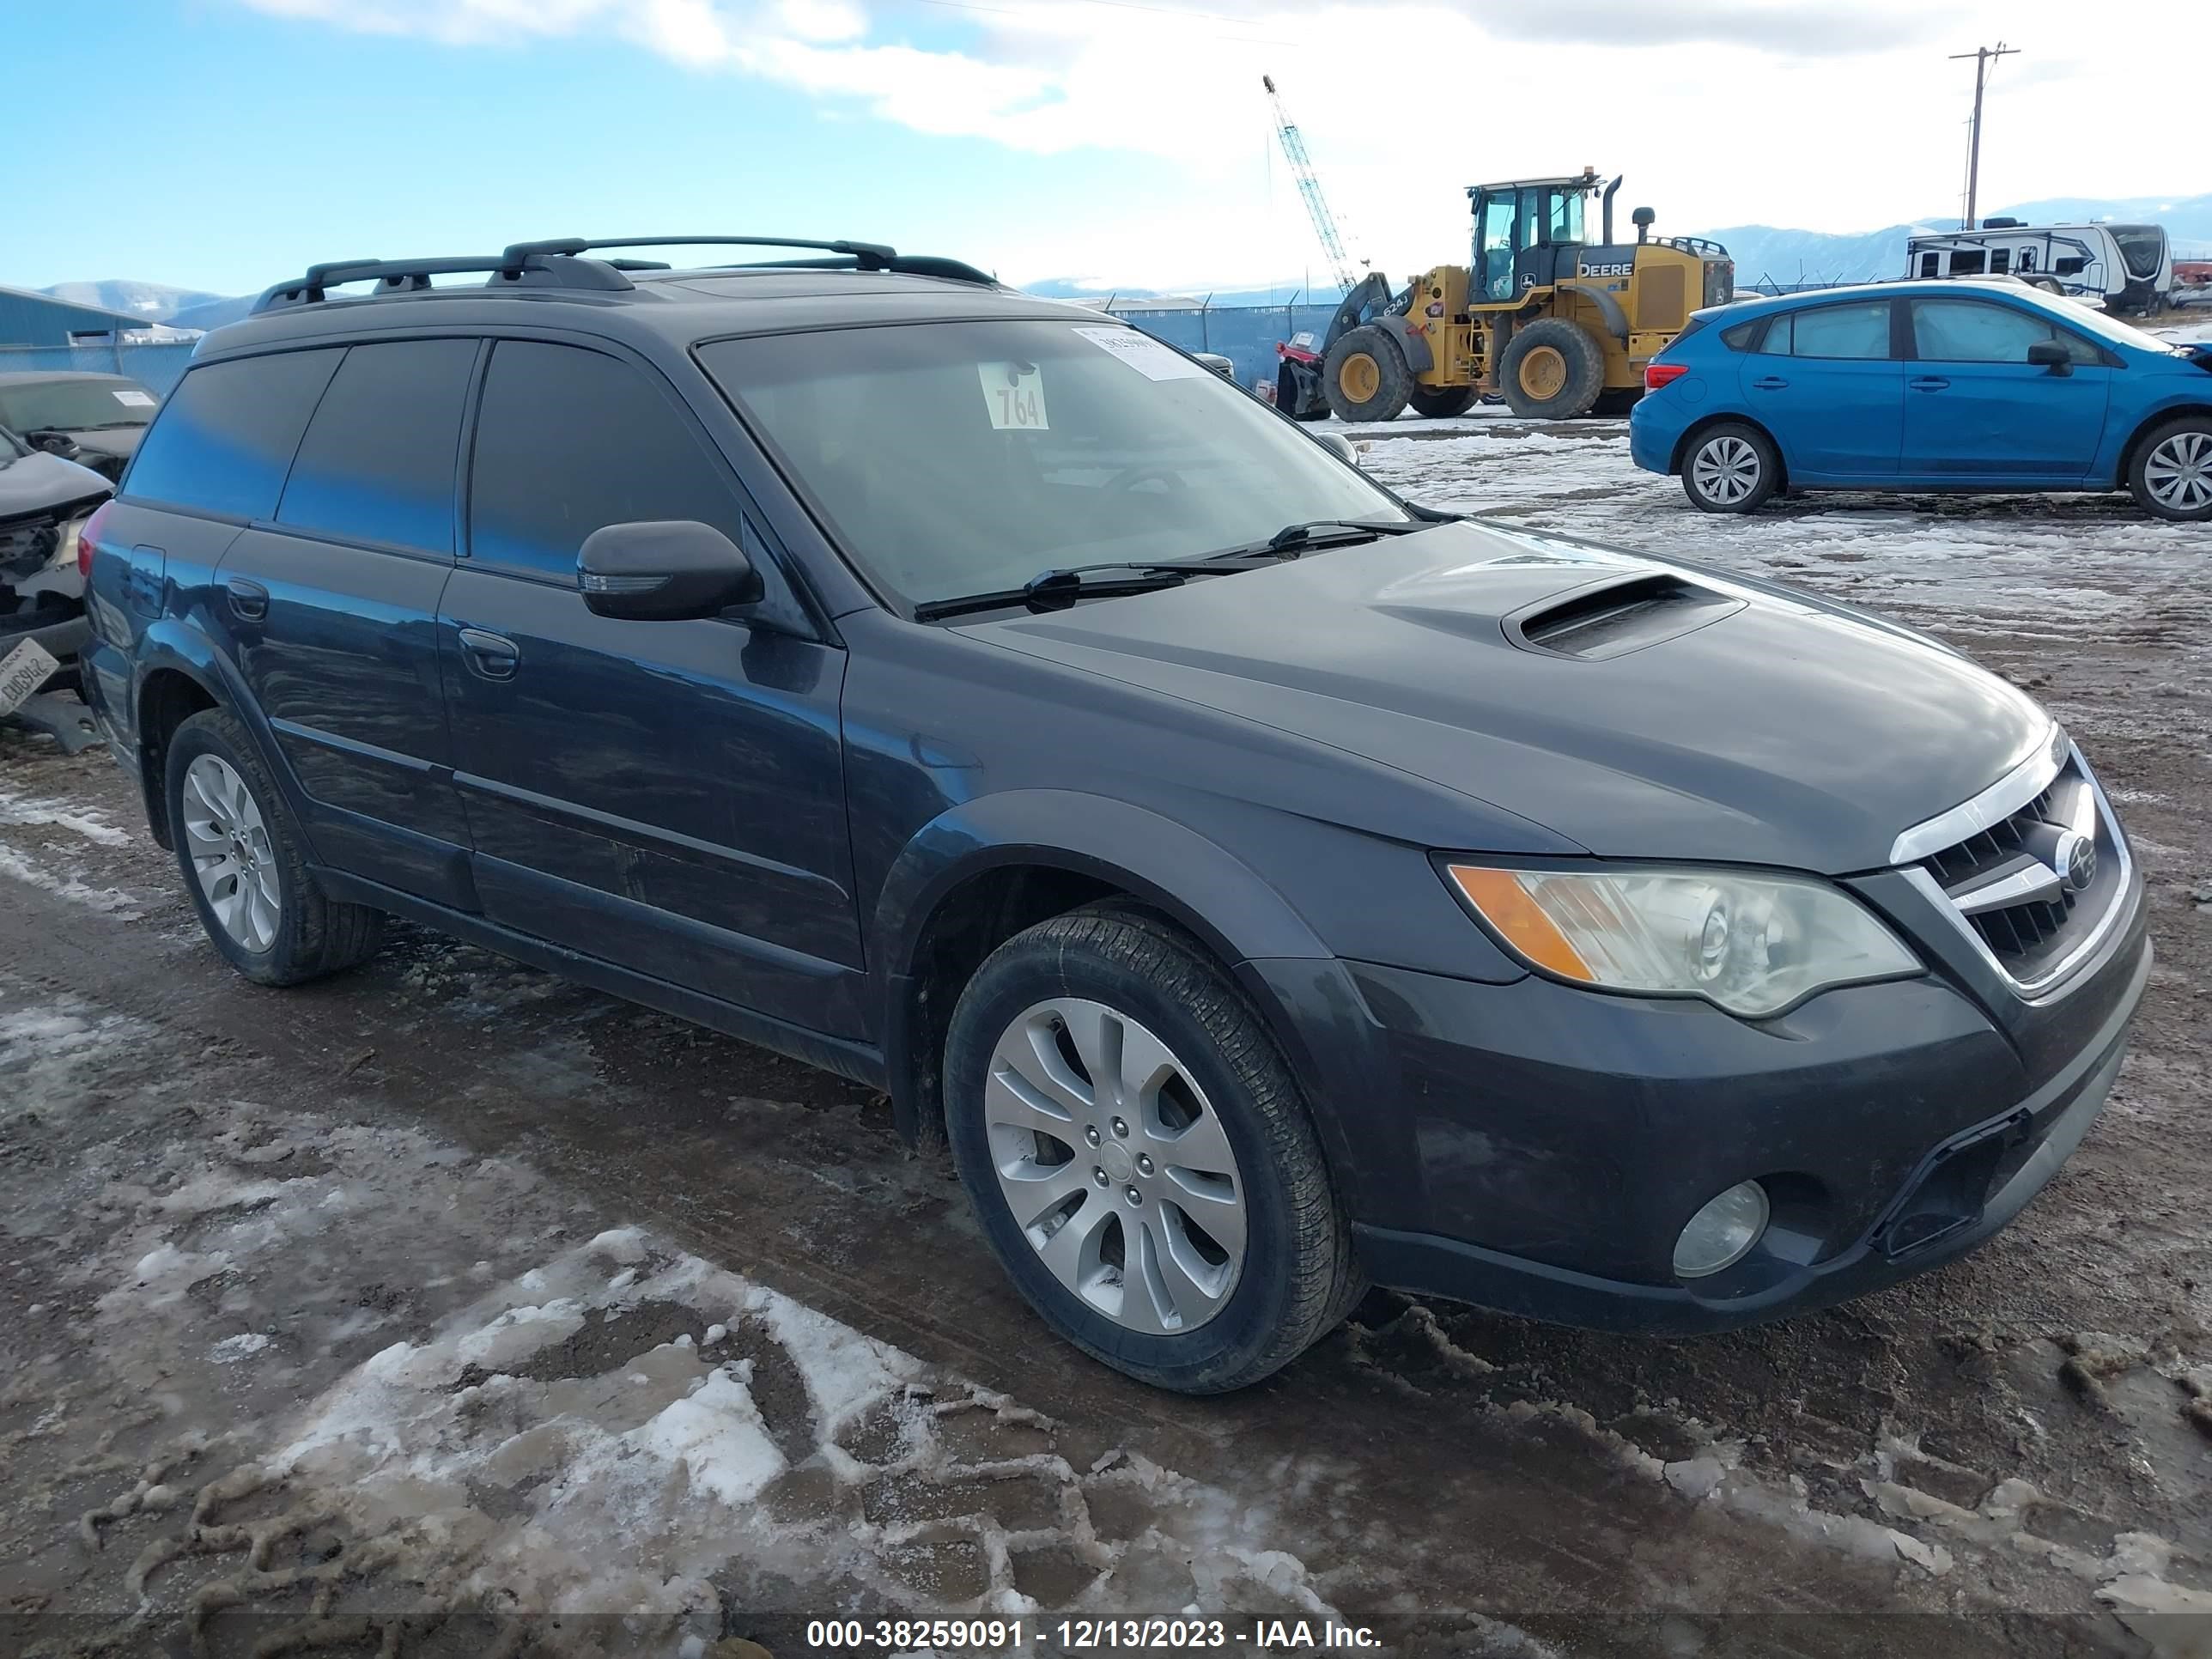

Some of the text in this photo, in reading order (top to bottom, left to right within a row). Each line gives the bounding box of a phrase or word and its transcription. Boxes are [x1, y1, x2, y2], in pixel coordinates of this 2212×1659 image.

[1579, 263, 1633, 277] DEERE
[1382, 295, 1409, 317] 624J
[996, 389, 1039, 426] 764
